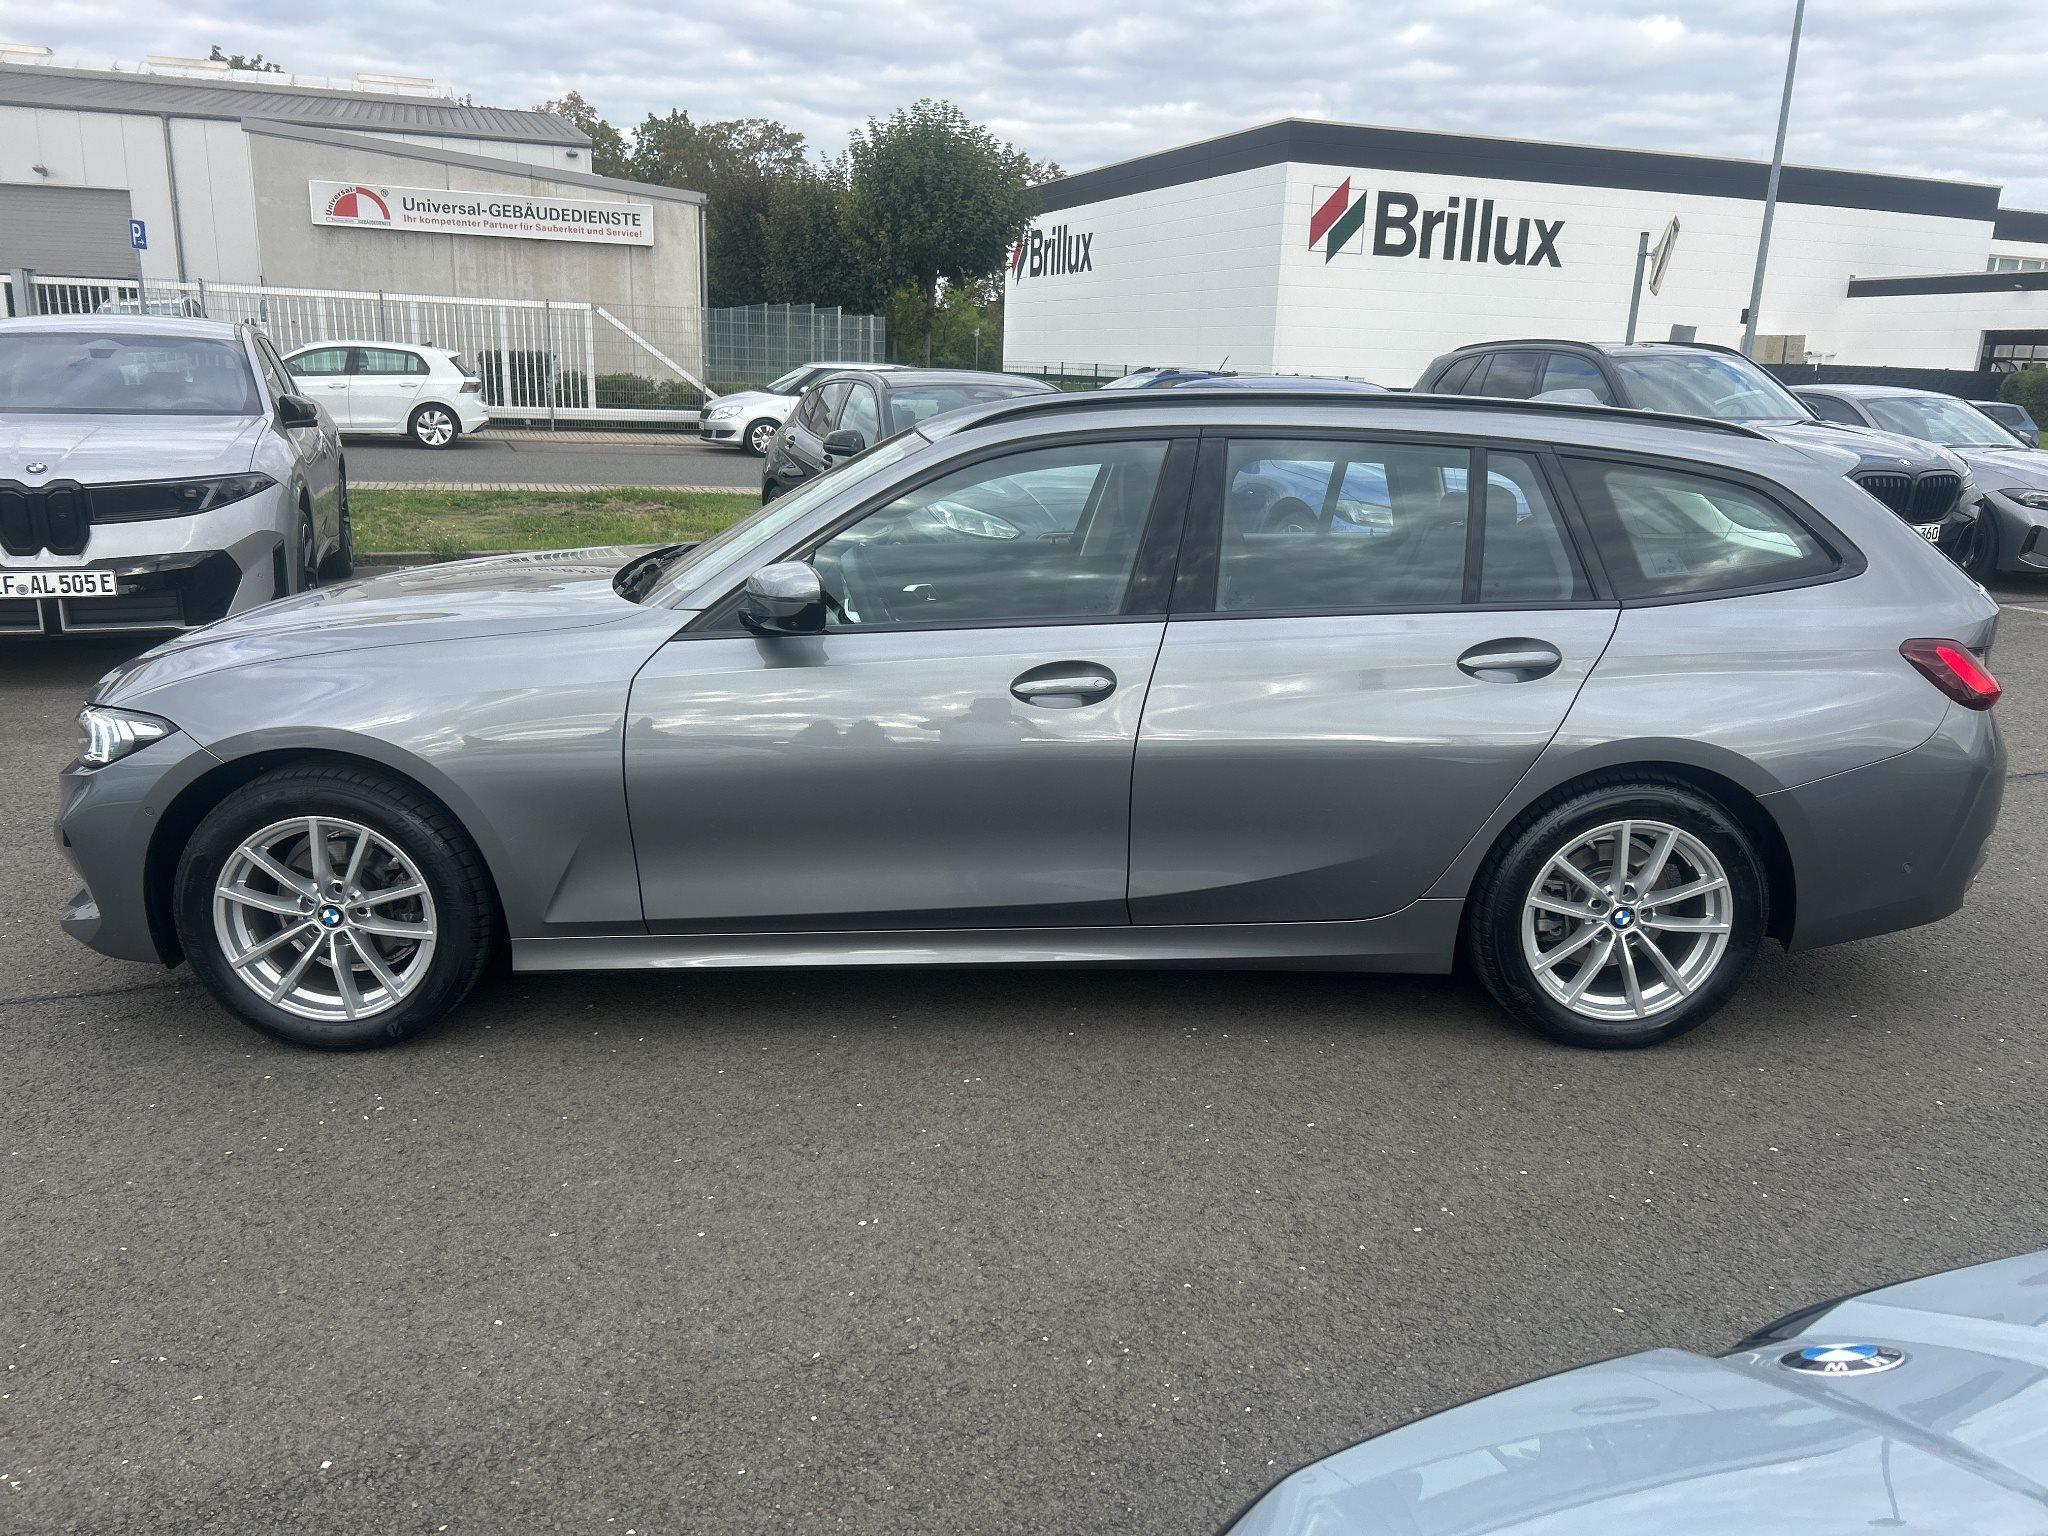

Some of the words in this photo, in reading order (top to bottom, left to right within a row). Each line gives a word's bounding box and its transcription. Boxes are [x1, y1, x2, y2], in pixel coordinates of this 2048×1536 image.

[402, 196, 641, 226] Universal-GEBÄUDEDIENSTE
[132, 223, 141, 245] P
[403, 214, 416, 223] Ihr
[420, 216, 480, 228] kompetenter
[483, 219, 517, 230] Partner
[520, 222, 533, 231] für
[535, 223, 584, 235] Sauberkeit
[587, 227, 604, 235] und
[606, 228, 642, 237] Service!
[1373, 190, 1566, 268] Brillux
[1030, 225, 1093, 277] Brillux
[0, 575, 14, 594] F
